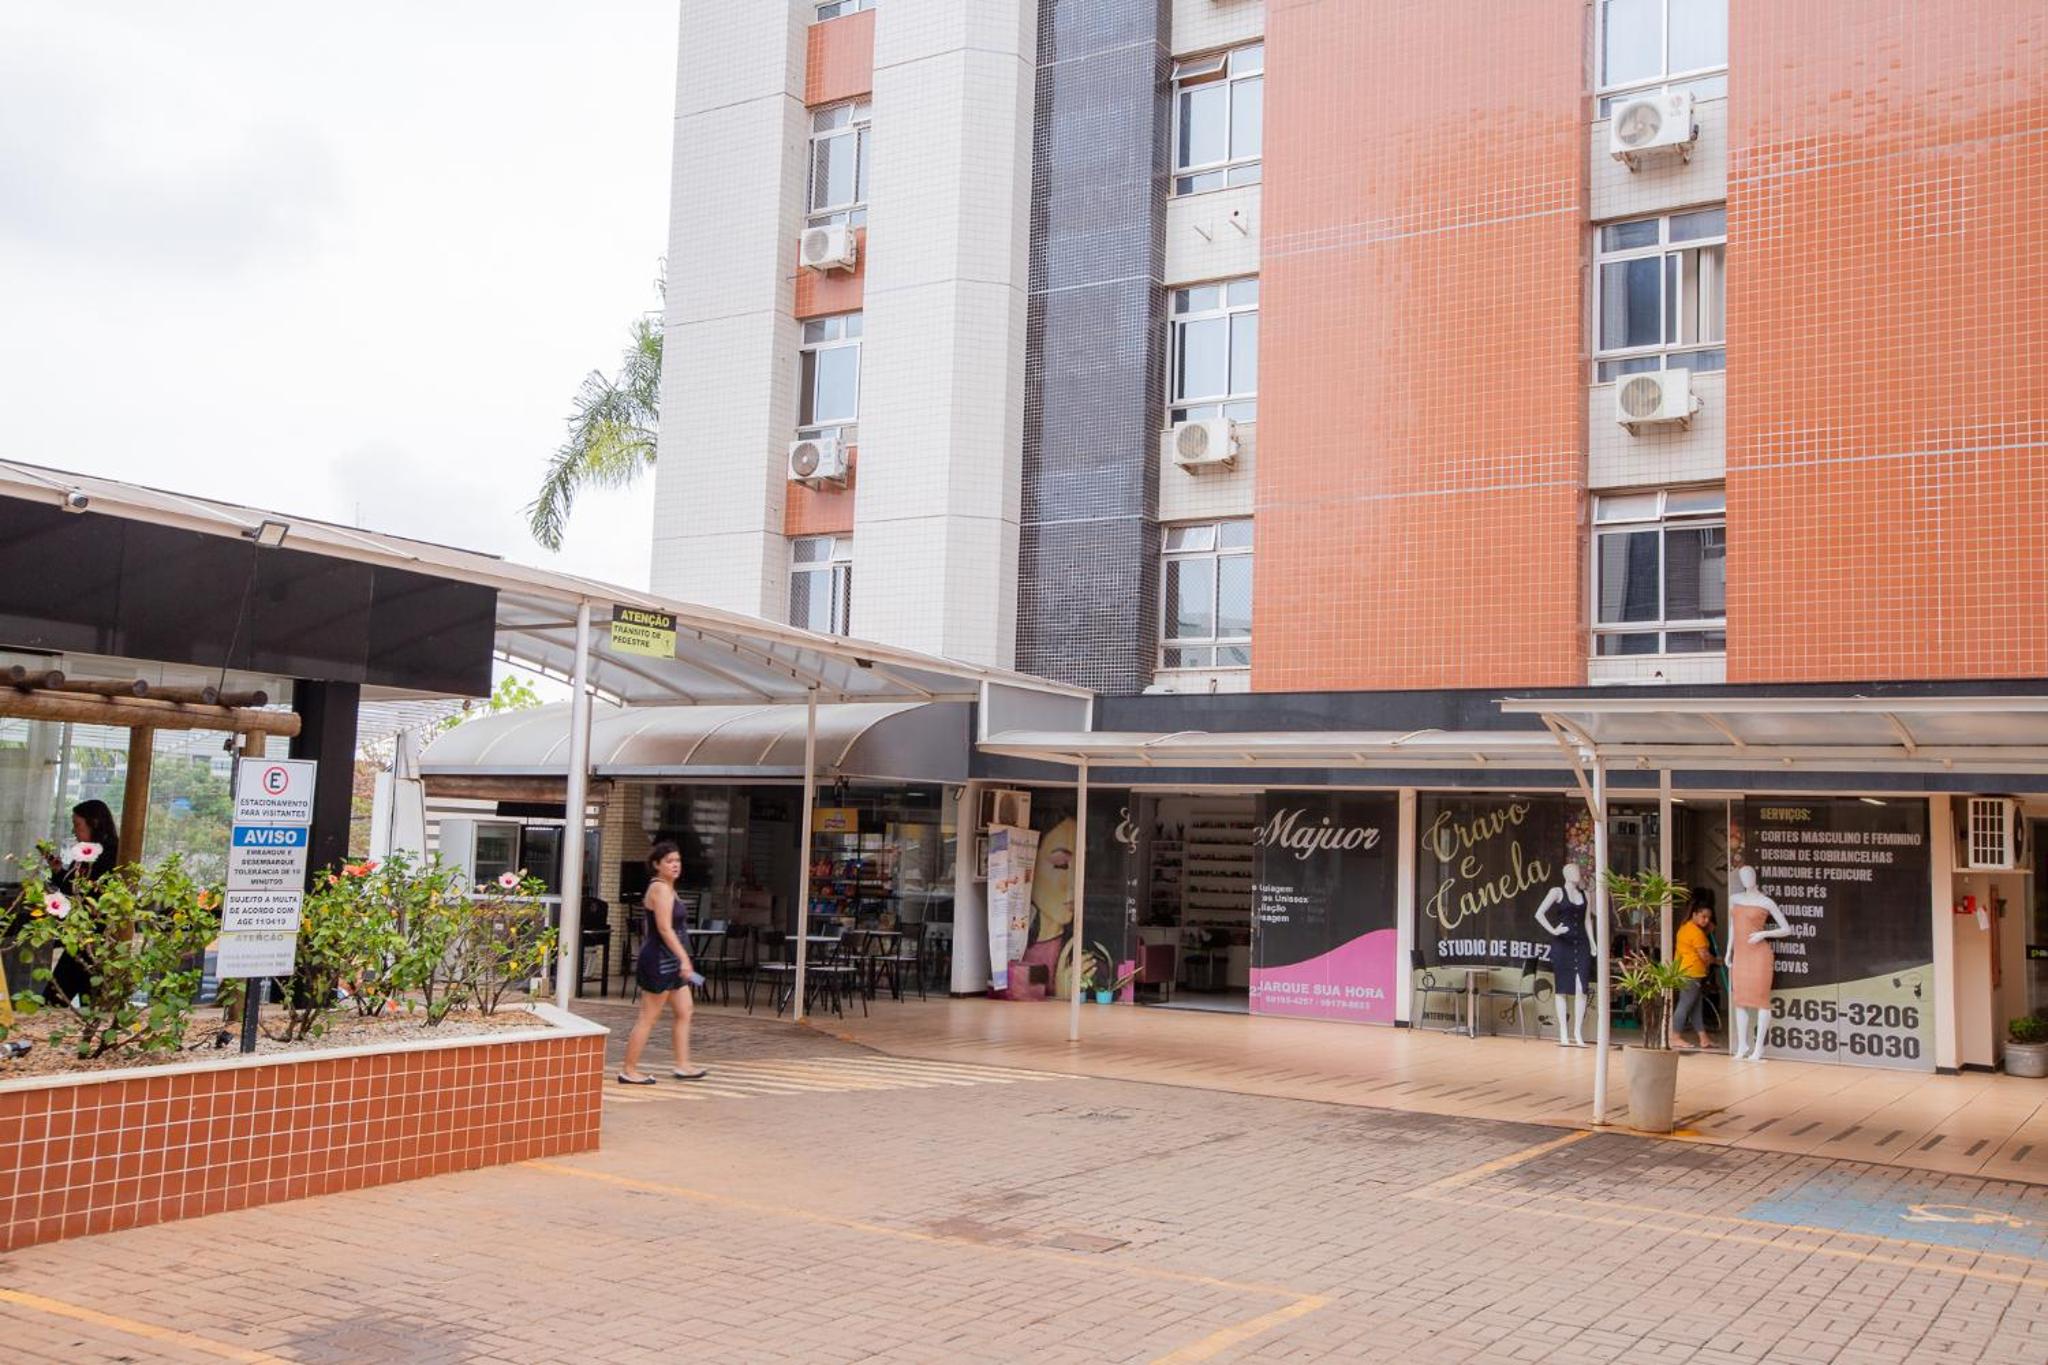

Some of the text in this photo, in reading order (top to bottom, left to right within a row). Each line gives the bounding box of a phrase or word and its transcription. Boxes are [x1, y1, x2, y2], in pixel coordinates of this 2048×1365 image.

[620, 609, 670, 628] ATENÇÃO
[612, 634, 651, 648] PEDESTRE
[651, 631, 662, 640] DE
[270, 772, 282, 789] E
[240, 799, 308, 808] ESTACIONAMENTO
[240, 809, 306, 818] PARA VISITANTES
[244, 829, 298, 844] AVISO
[1252, 807, 1380, 861] Majuor
[1421, 800, 1530, 863] Cravo
[1760, 830, 1922, 846] CORTES MASCULINO E FEMININO
[1760, 848, 1894, 863] DESIGN DE SOBRANCELHAS
[1461, 855, 1483, 878] e
[1760, 866, 1873, 882] MANICURE E PEDICURE
[250, 878, 284, 886] MINUTOS
[1426, 840, 1551, 929] Canela
[1761, 883, 1828, 899] SPA DOS PÉS
[1438, 938, 1552, 962] STUDIO DE BELEZ
[1312, 983, 1341, 996] SUA
[1345, 985, 1385, 999] HORA
[1770, 996, 1920, 1030] 3465-3206
